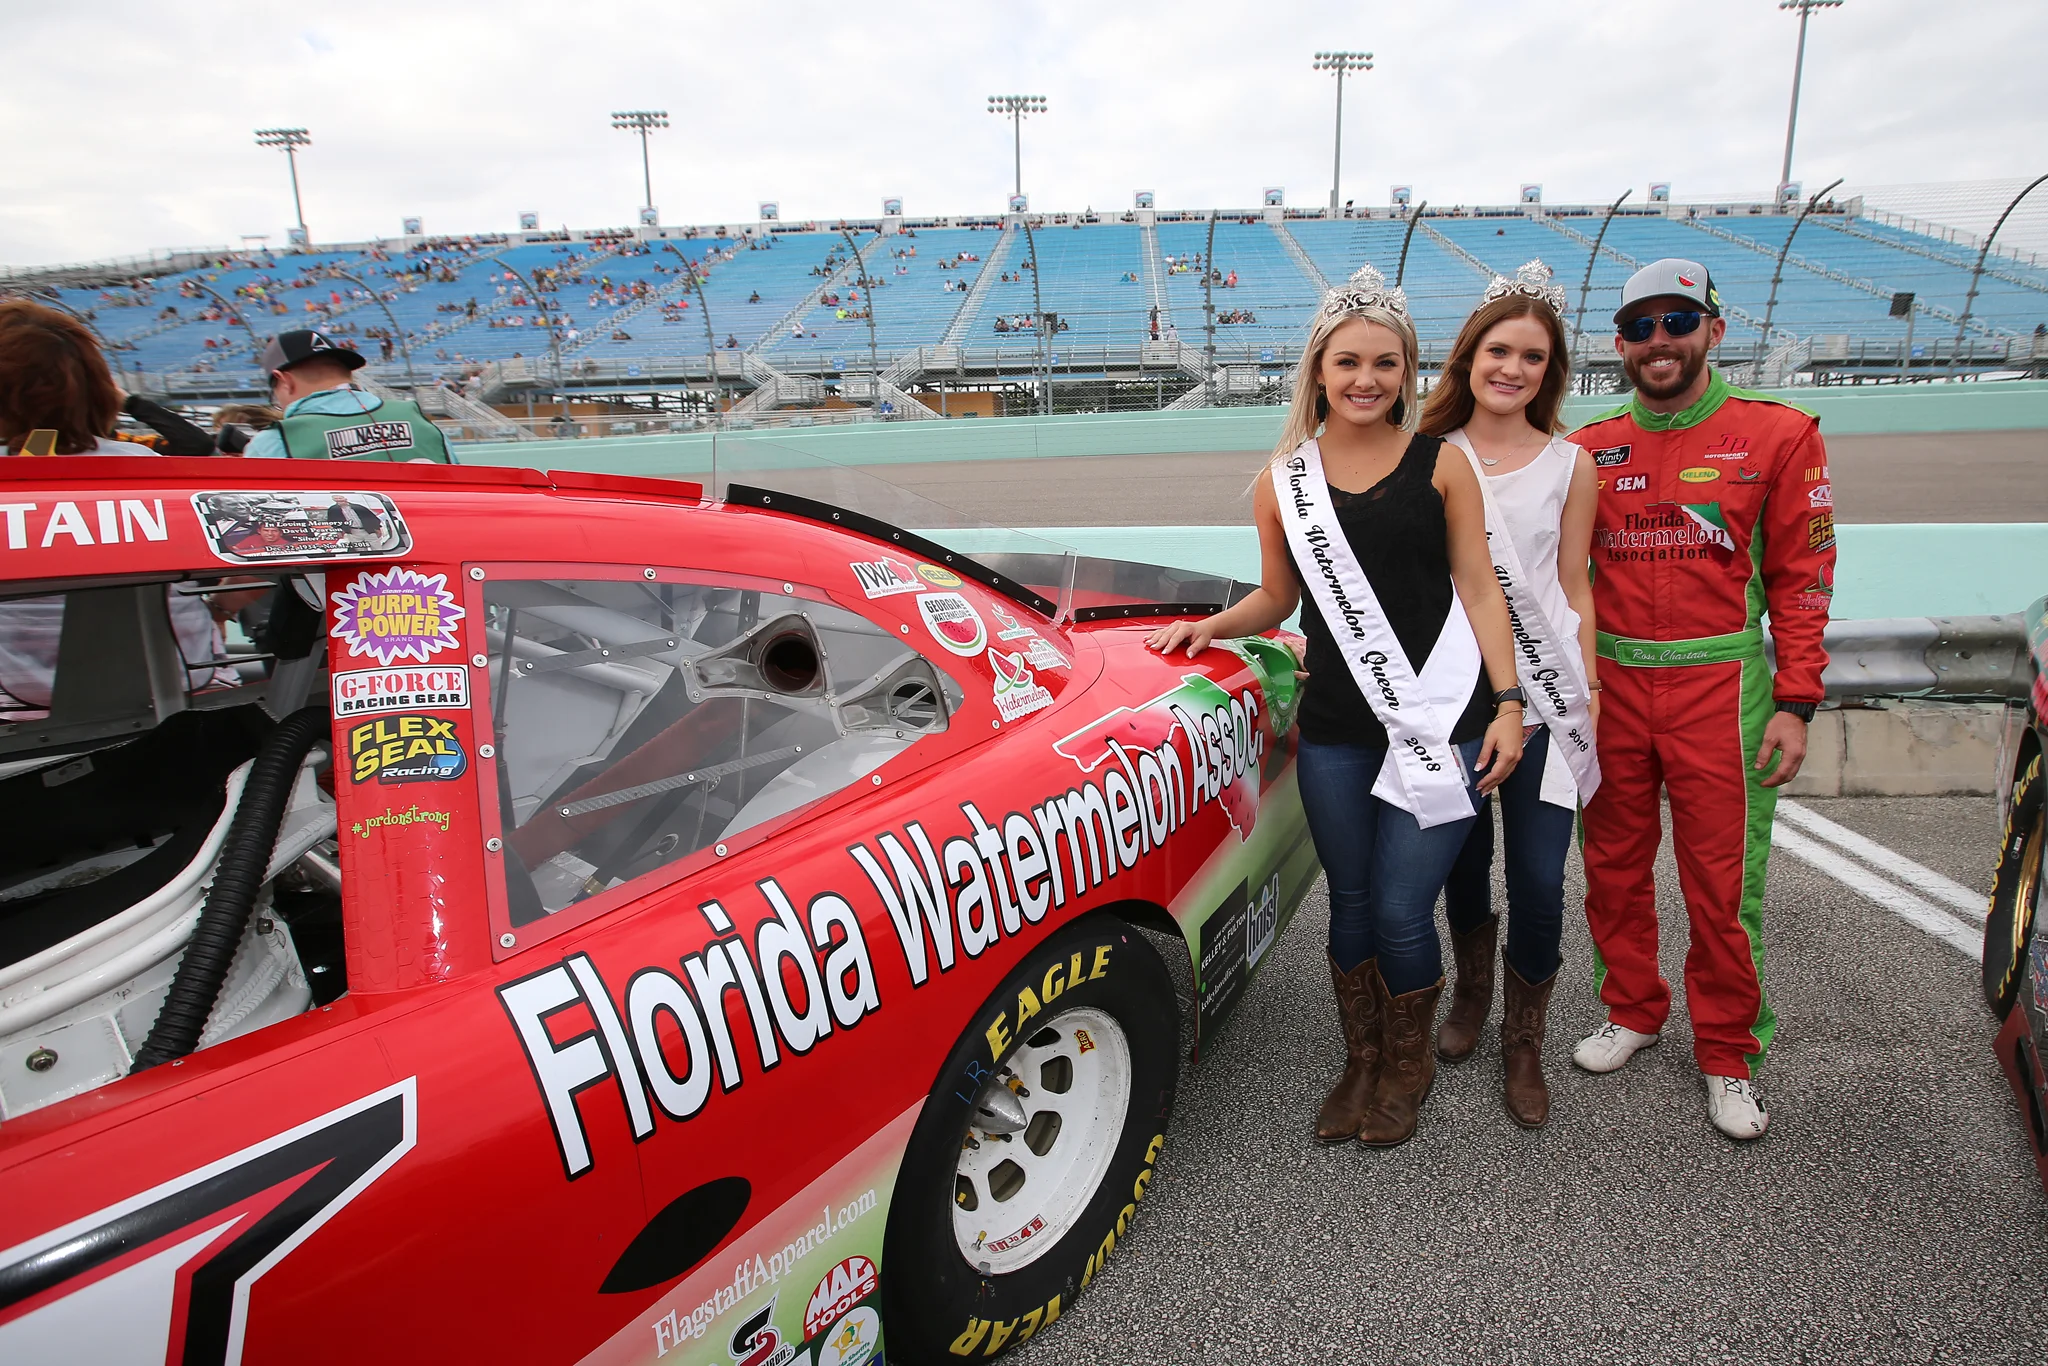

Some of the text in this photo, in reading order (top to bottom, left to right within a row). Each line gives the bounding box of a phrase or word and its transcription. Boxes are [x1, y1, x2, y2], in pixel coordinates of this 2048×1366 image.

[355, 423, 411, 443] NASCAR
[352, 439, 411, 453] PRODUCTIONS
[1596, 452, 1625, 464] xfinity
[1616, 475, 1646, 491] SEM
[1681, 470, 1716, 480] HELENA
[0, 499, 168, 549] TAIN
[1625, 511, 1685, 530] Florida
[1808, 513, 1833, 535] FLE
[1594, 522, 1727, 548] Watermelon
[1607, 547, 1708, 562] Association
[853, 563, 905, 589] IWA
[357, 594, 440, 618] PURPLE
[924, 598, 962, 613] GEORGIA
[932, 610, 968, 622] WATERMELON
[1287, 456, 1441, 772] Florida Watermelon Queen 2018
[357, 615, 440, 638] POWER
[1632, 648, 1708, 661] Ross Chastain
[341, 672, 462, 698] G-FORCE
[343, 693, 461, 711] RACING GEAR
[996, 686, 1049, 713] Watermelon
[1004, 697, 1053, 719] ASSOCIATION
[1532, 669, 1568, 717] Queen
[1568, 729, 1588, 753] 2018
[352, 717, 456, 755] FLEX
[355, 739, 457, 781] SEAL
[381, 765, 455, 778] Racing
[352, 805, 450, 838] #jordonstrong
[498, 689, 1264, 1180] Florida Watermelon Assoc.
[1201, 944, 1222, 972] KELLEY
[1227, 912, 1247, 940] FULTON
[985, 944, 1112, 1064] EAGLE
[651, 1188, 877, 1359] FlagstaffApparel.com
[806, 1256, 875, 1324] MAC
[806, 1277, 876, 1336] TOOLS
